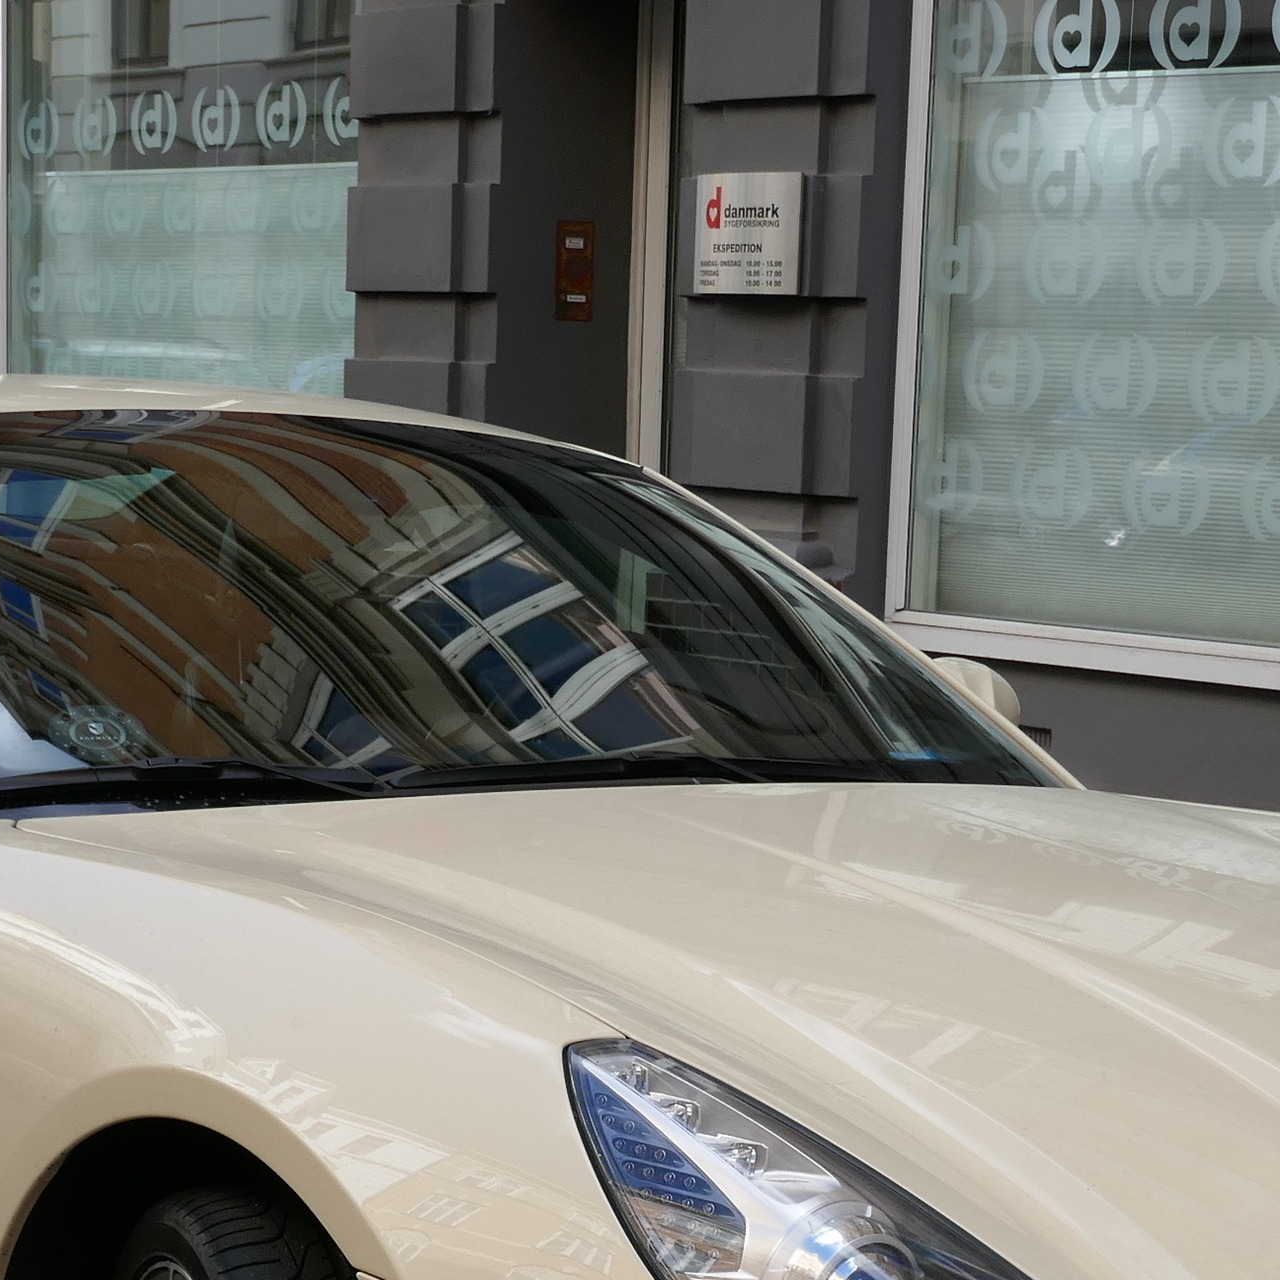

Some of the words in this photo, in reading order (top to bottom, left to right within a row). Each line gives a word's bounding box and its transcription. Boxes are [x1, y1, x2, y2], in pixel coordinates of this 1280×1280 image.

[724, 204, 779, 218] danmark
[723, 219, 780, 228] SYGEFORSIKRING
[713, 243, 763, 253] EKSPEDITION
